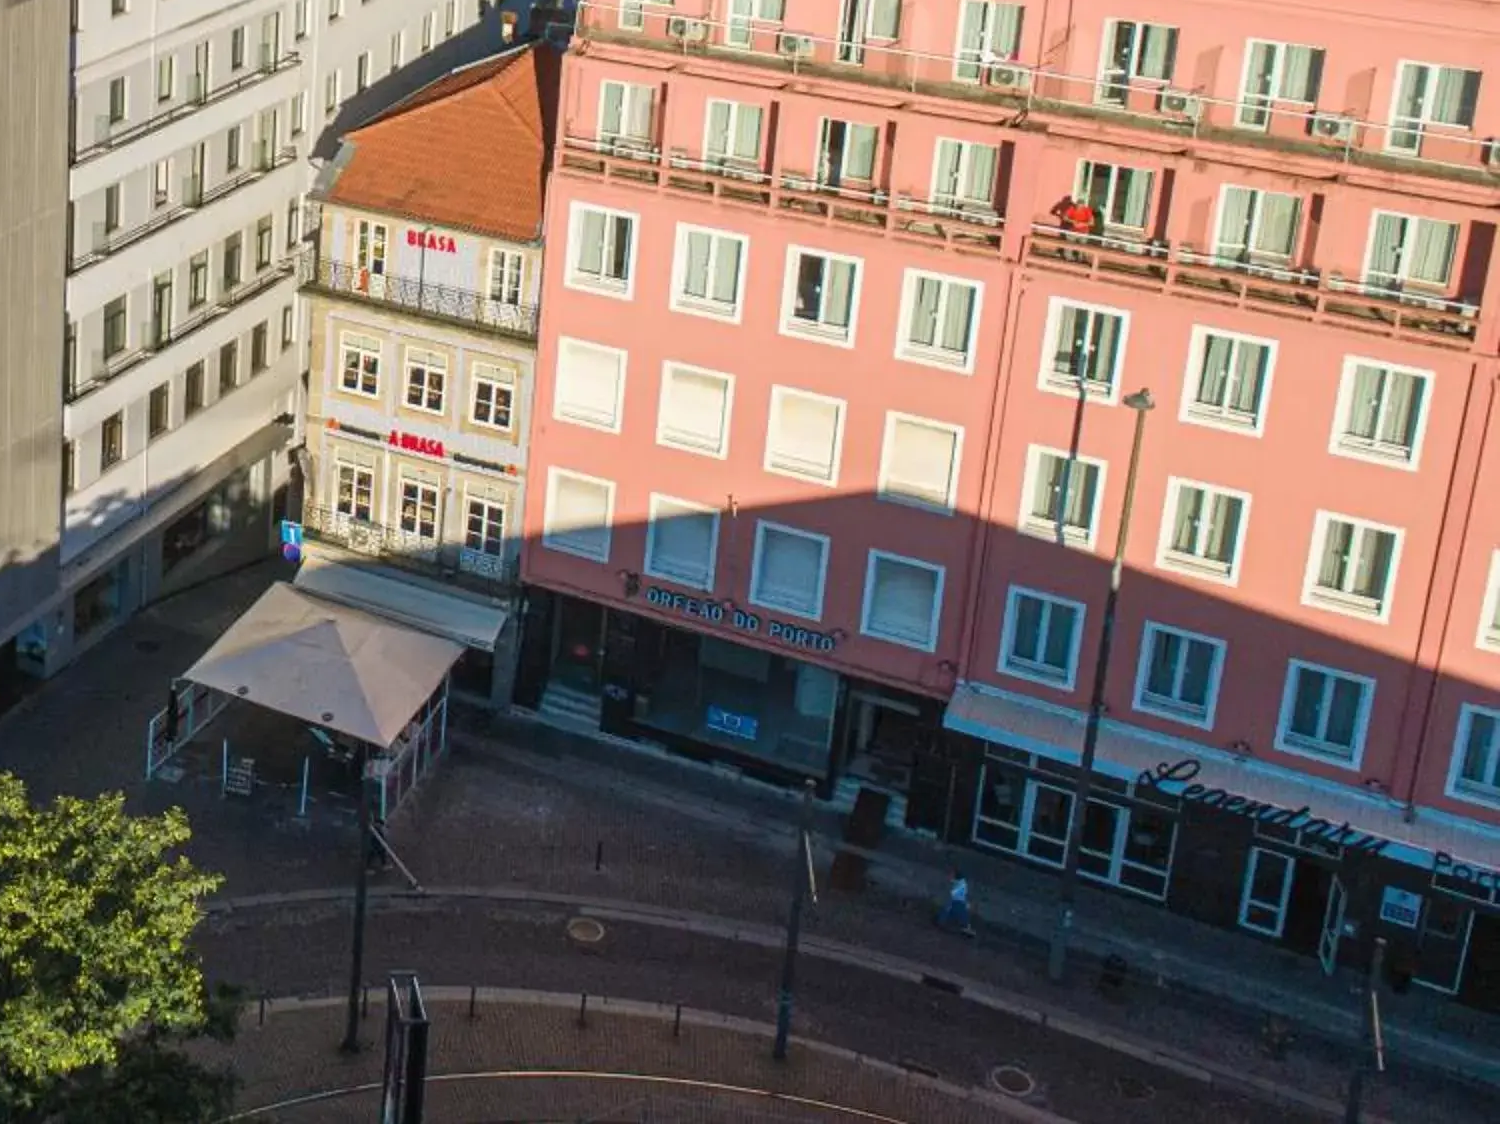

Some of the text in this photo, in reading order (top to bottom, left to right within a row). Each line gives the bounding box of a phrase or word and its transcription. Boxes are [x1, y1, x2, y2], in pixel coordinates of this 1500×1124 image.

[407, 229, 457, 253] BRASA
[401, 432, 445, 457] BRASA
[732, 609, 760, 633] DO
[768, 620, 835, 653] PORTO
